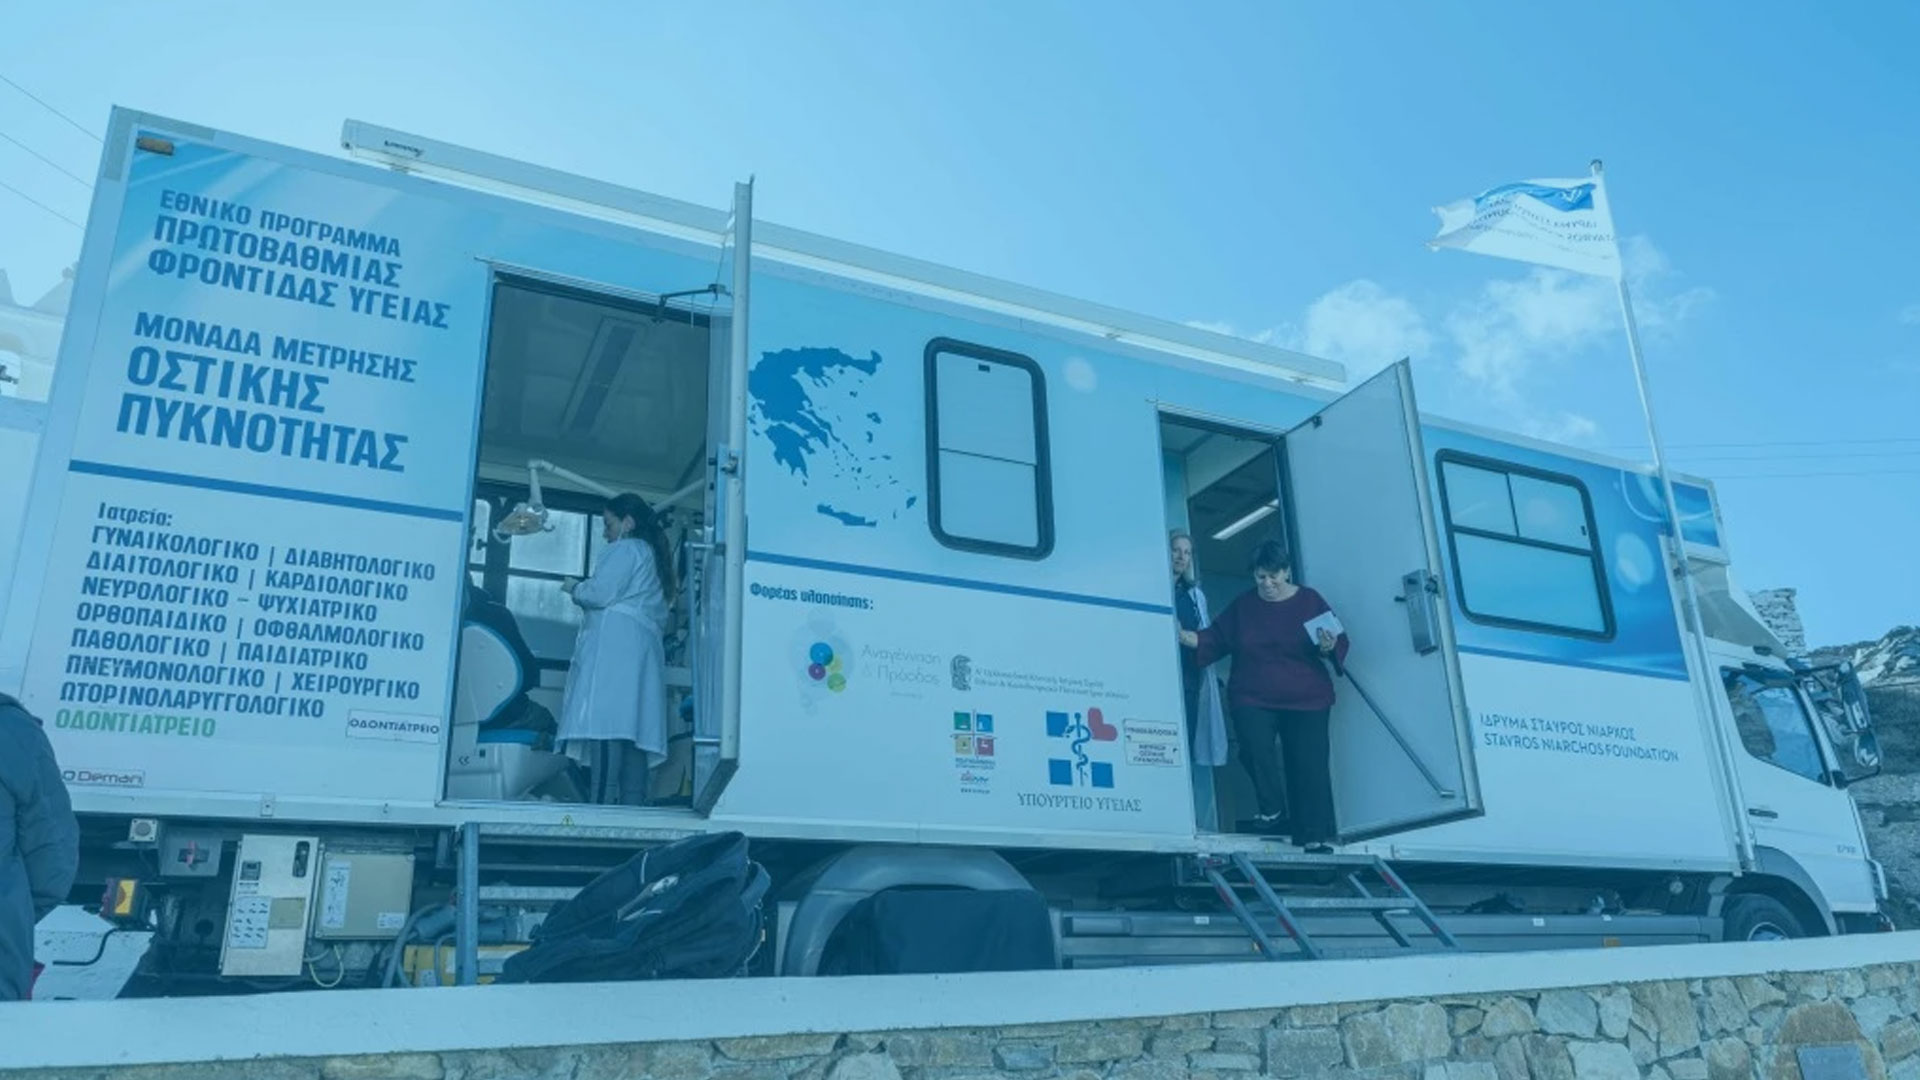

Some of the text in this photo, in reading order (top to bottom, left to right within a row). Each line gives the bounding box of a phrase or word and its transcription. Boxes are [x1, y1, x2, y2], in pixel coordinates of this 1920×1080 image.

[161, 189, 401, 258] ΕΘΝΙΚΟ ΠΡΟΓΡΑΜΜΑ
[154, 216, 402, 288] ΠΡΩΤΟΒΑΘΜΙΑΣ
[148, 248, 451, 329] ΦΡΟΝΤΙΔΑΣ ΥΓΕΙΑΣ
[134, 312, 418, 382] ΜΟΝΑΔΑ ΜΕΤΡΗΣΗΣ
[127, 346, 329, 413] ΟΣΤΙΚΗΣ
[117, 392, 409, 472] ΠΥΚΝΟΤΗΤΑΣ
[98, 502, 173, 527] Ιατρεία:
[91, 525, 259, 561] ΓΥΝΑΙΚΟΛΟΓΙΚΟ
[284, 547, 436, 581] ΔΙΑΒΗΤΟΛΟΓΙΚΟ
[81, 576, 229, 608] ΝΕΥΡΟΛΟΓΙΚΟ
[258, 594, 378, 622] ΨΥΧΙΑΤΡΙΚΟ
[86, 551, 239, 584] ΔΙΑΙΤΟΛΟΓΙΚΟ
[265, 569, 408, 602] ΚΑΡΔΙΟΛΟΓΙΚΟ
[71, 628, 210, 658] ΠΑΘΟΛΟΓΙΚΟ
[236, 643, 368, 670] ΠΑΙΔΙΑΤΡΙΚΟ
[76, 602, 227, 634] ΟΡΘΟΠΑΙΔΙΚΟ
[253, 618, 424, 651] ΟΦΘΑΛΜΟΛΟΓΙΚΟ
[59, 681, 325, 718] ΩΤΟΡΙΝΟΛΑΡΥΓΓΟΛΟΓΙΚΟ
[65, 654, 265, 688] ΠΝΕΥΜΟΝΟΛΟΓΙΚΟ
[290, 672, 420, 700] ΧΕΙΡΟΥΡΓΙΚΟ
[55, 709, 217, 737] ΟΔΟΝΤΙΑΤΡΕΙΟ
[349, 718, 440, 735] ΟΔΟΝΤΙΑΤΡΕΙΟ
[1480, 712, 1637, 742] ΙΔΡΥΜΑ ΣΤΑΥΡΟΣ ΝΙΑΡΧΟΣ
[1484, 733, 1680, 762] STAVROS NIARCHOS FOUNDATION
[1017, 792, 1142, 812] ΥΠΟΥΡΓΕΙΟ ΥΓΕΙΑΣ
